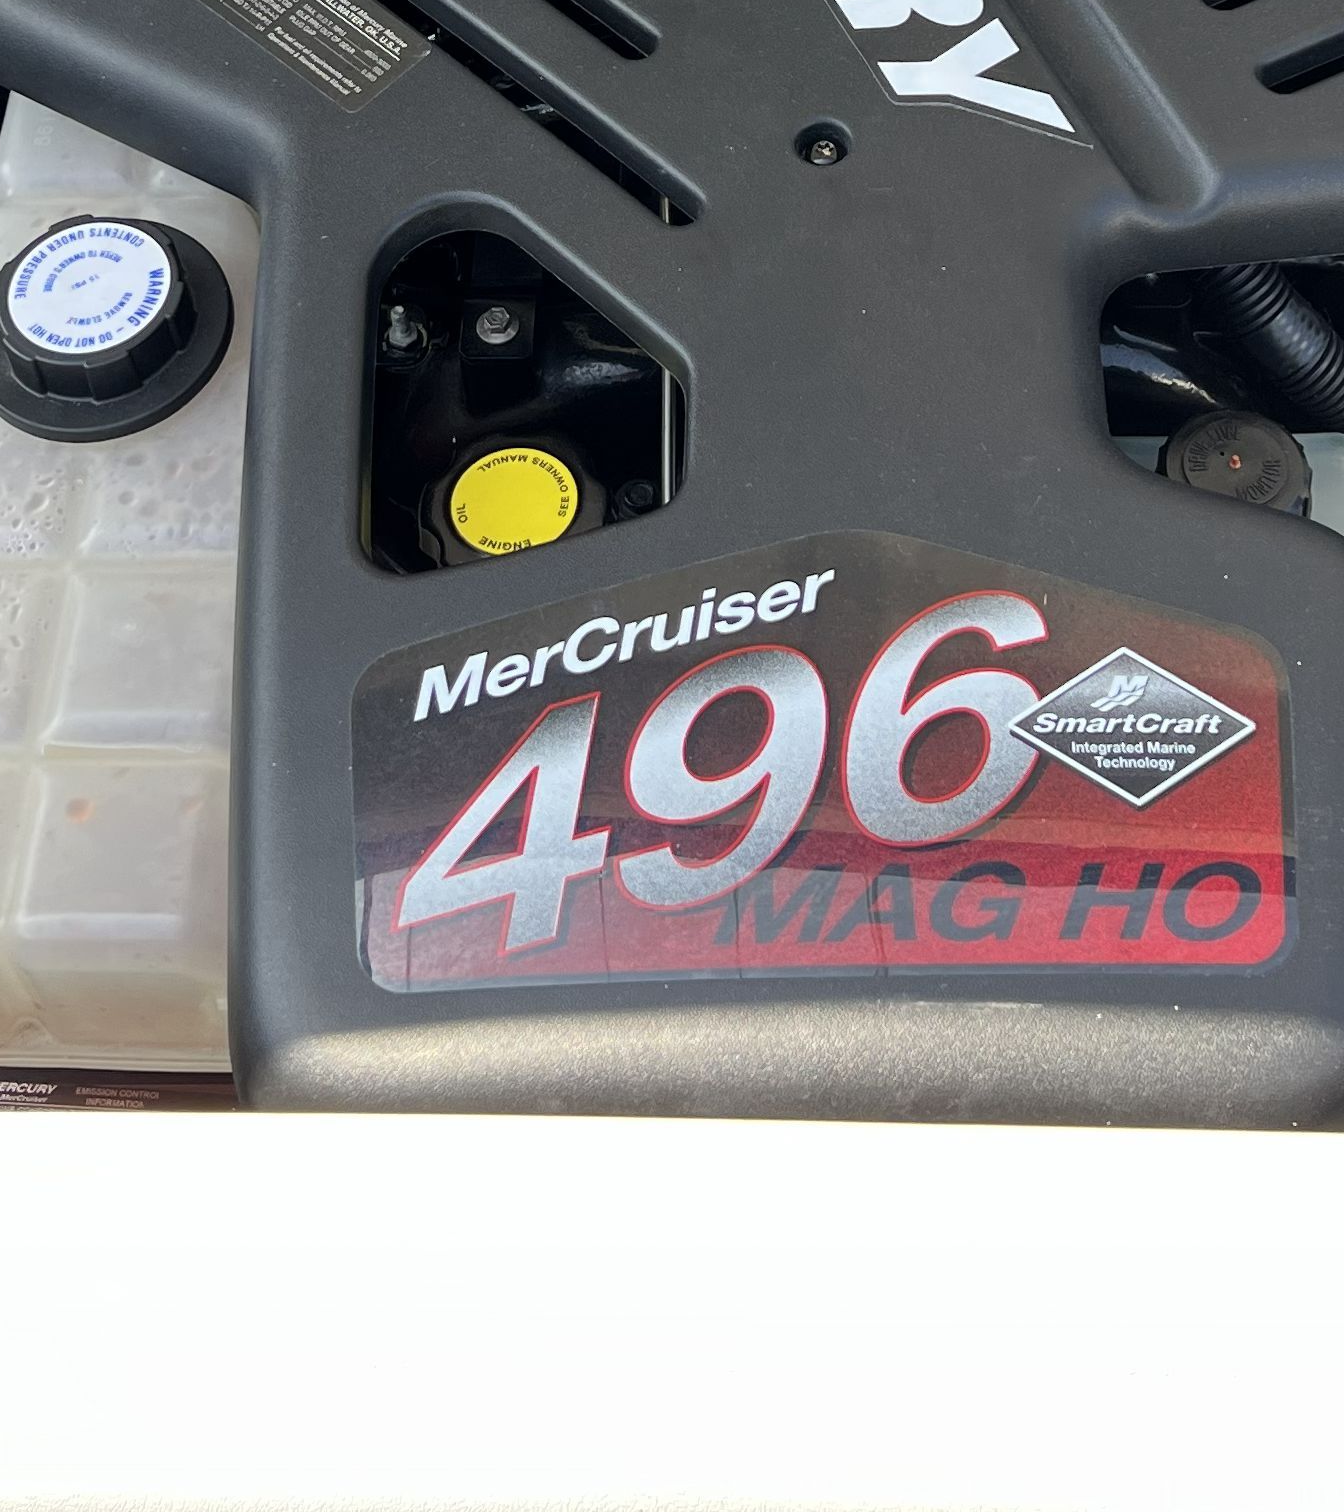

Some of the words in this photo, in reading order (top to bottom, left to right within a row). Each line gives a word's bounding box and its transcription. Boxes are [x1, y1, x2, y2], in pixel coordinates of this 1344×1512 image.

[356, 9, 386, 32] Mercury
[383, 28, 408, 48] Marine
[378, 35, 403, 54] U.S.A.
[49, 230, 85, 253] UNDER
[88, 227, 144, 248] CONTENTS
[53, 250, 85, 273] OWNER'S
[86, 250, 98, 259] TO
[102, 250, 122, 263] REFER
[14, 249, 47, 300] PRESSURE
[102, 292, 133, 319] REMOVE
[127, 268, 164, 326] WARNING
[27, 323, 46, 337] HOT
[66, 315, 103, 326] SLOWLY
[46, 333, 72, 348] OPEN
[74, 337, 97, 348] NOT
[100, 331, 113, 344] DO
[477, 454, 529, 473] MANUAL
[531, 456, 569, 493] OWNERS
[456, 503, 468, 524] OIL
[558, 495, 570, 518] SEE
[478, 536, 532, 551] ENGINE
[412, 568, 834, 722] MerCruiser
[1032, 712, 1223, 734] SmartCraft
[1071, 741, 1144, 755] Integrated
[1147, 741, 1196, 754] Marine
[1094, 756, 1176, 771] Technology
[393, 589, 1048, 960] 496
[716, 859, 1036, 946] MAG
[1057, 861, 1265, 941] HO
[0, 1093, 48, 1103] MerCruiser
[76, 1087, 117, 1098] EMISSION
